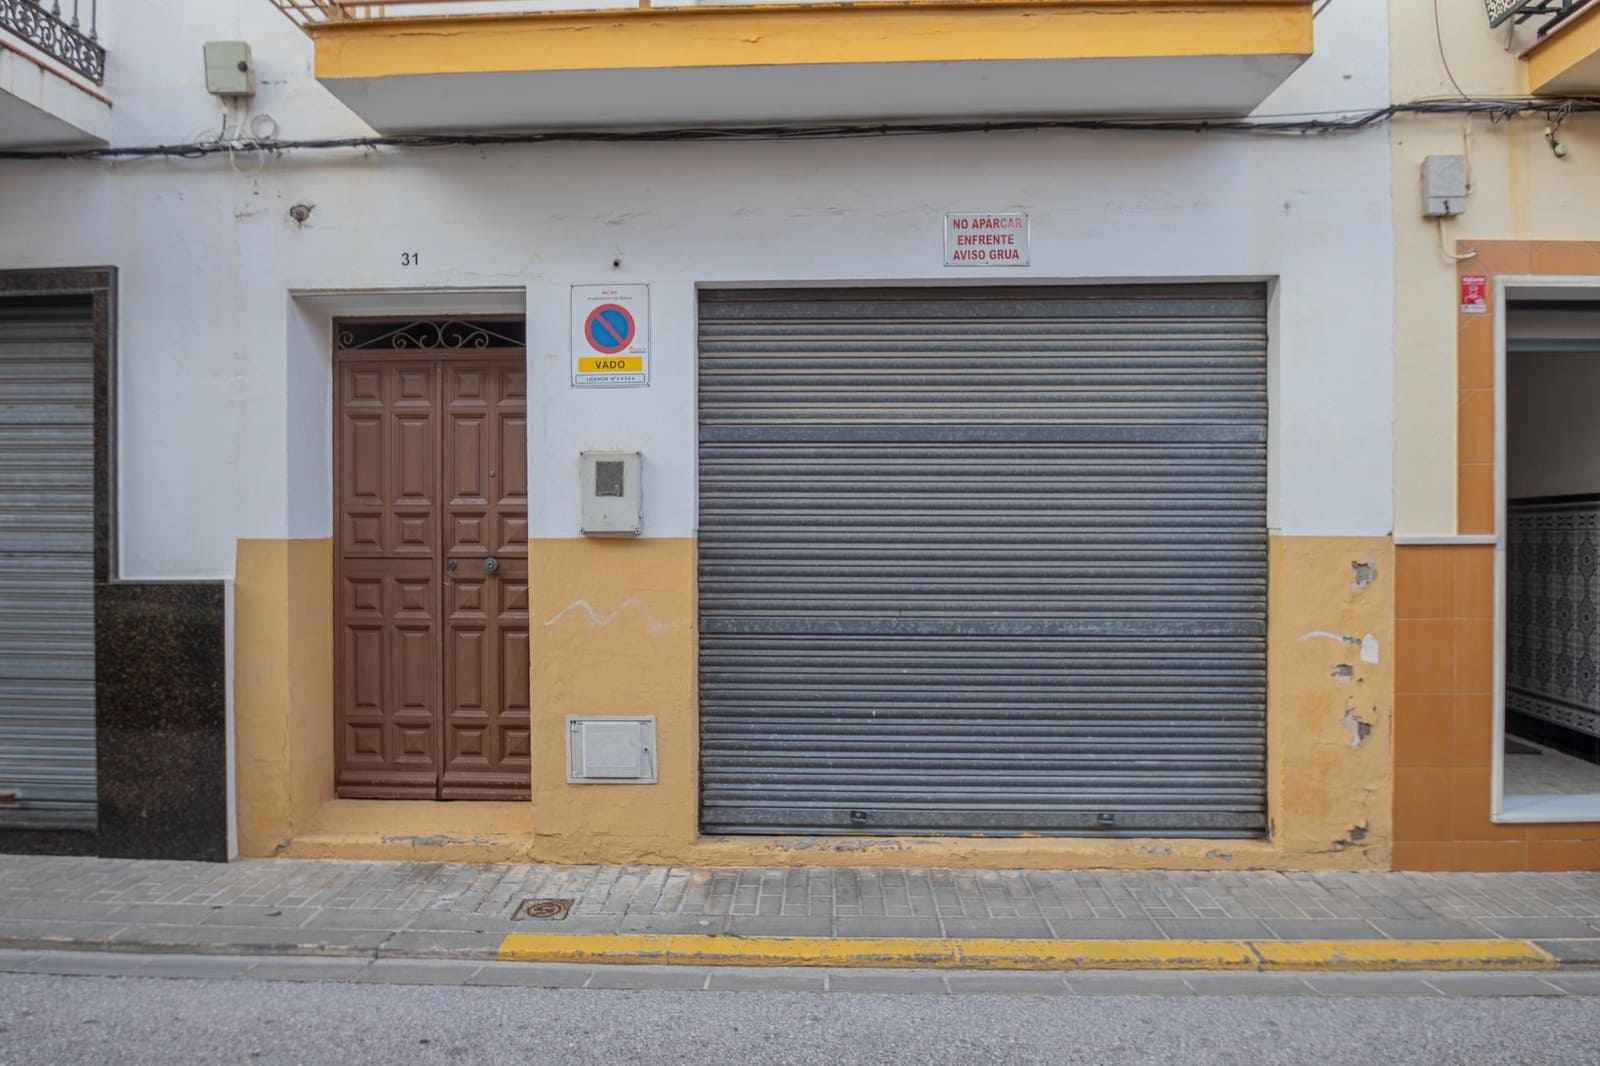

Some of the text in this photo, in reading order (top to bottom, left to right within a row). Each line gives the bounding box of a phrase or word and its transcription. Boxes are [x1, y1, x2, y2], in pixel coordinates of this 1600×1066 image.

[953, 217, 1023, 229] NO APARCAR
[957, 234, 1015, 245] ENFRENTE
[401, 252, 418, 266] 31
[953, 249, 1020, 260] AVISO GRUA
[595, 360, 625, 369] VADO
